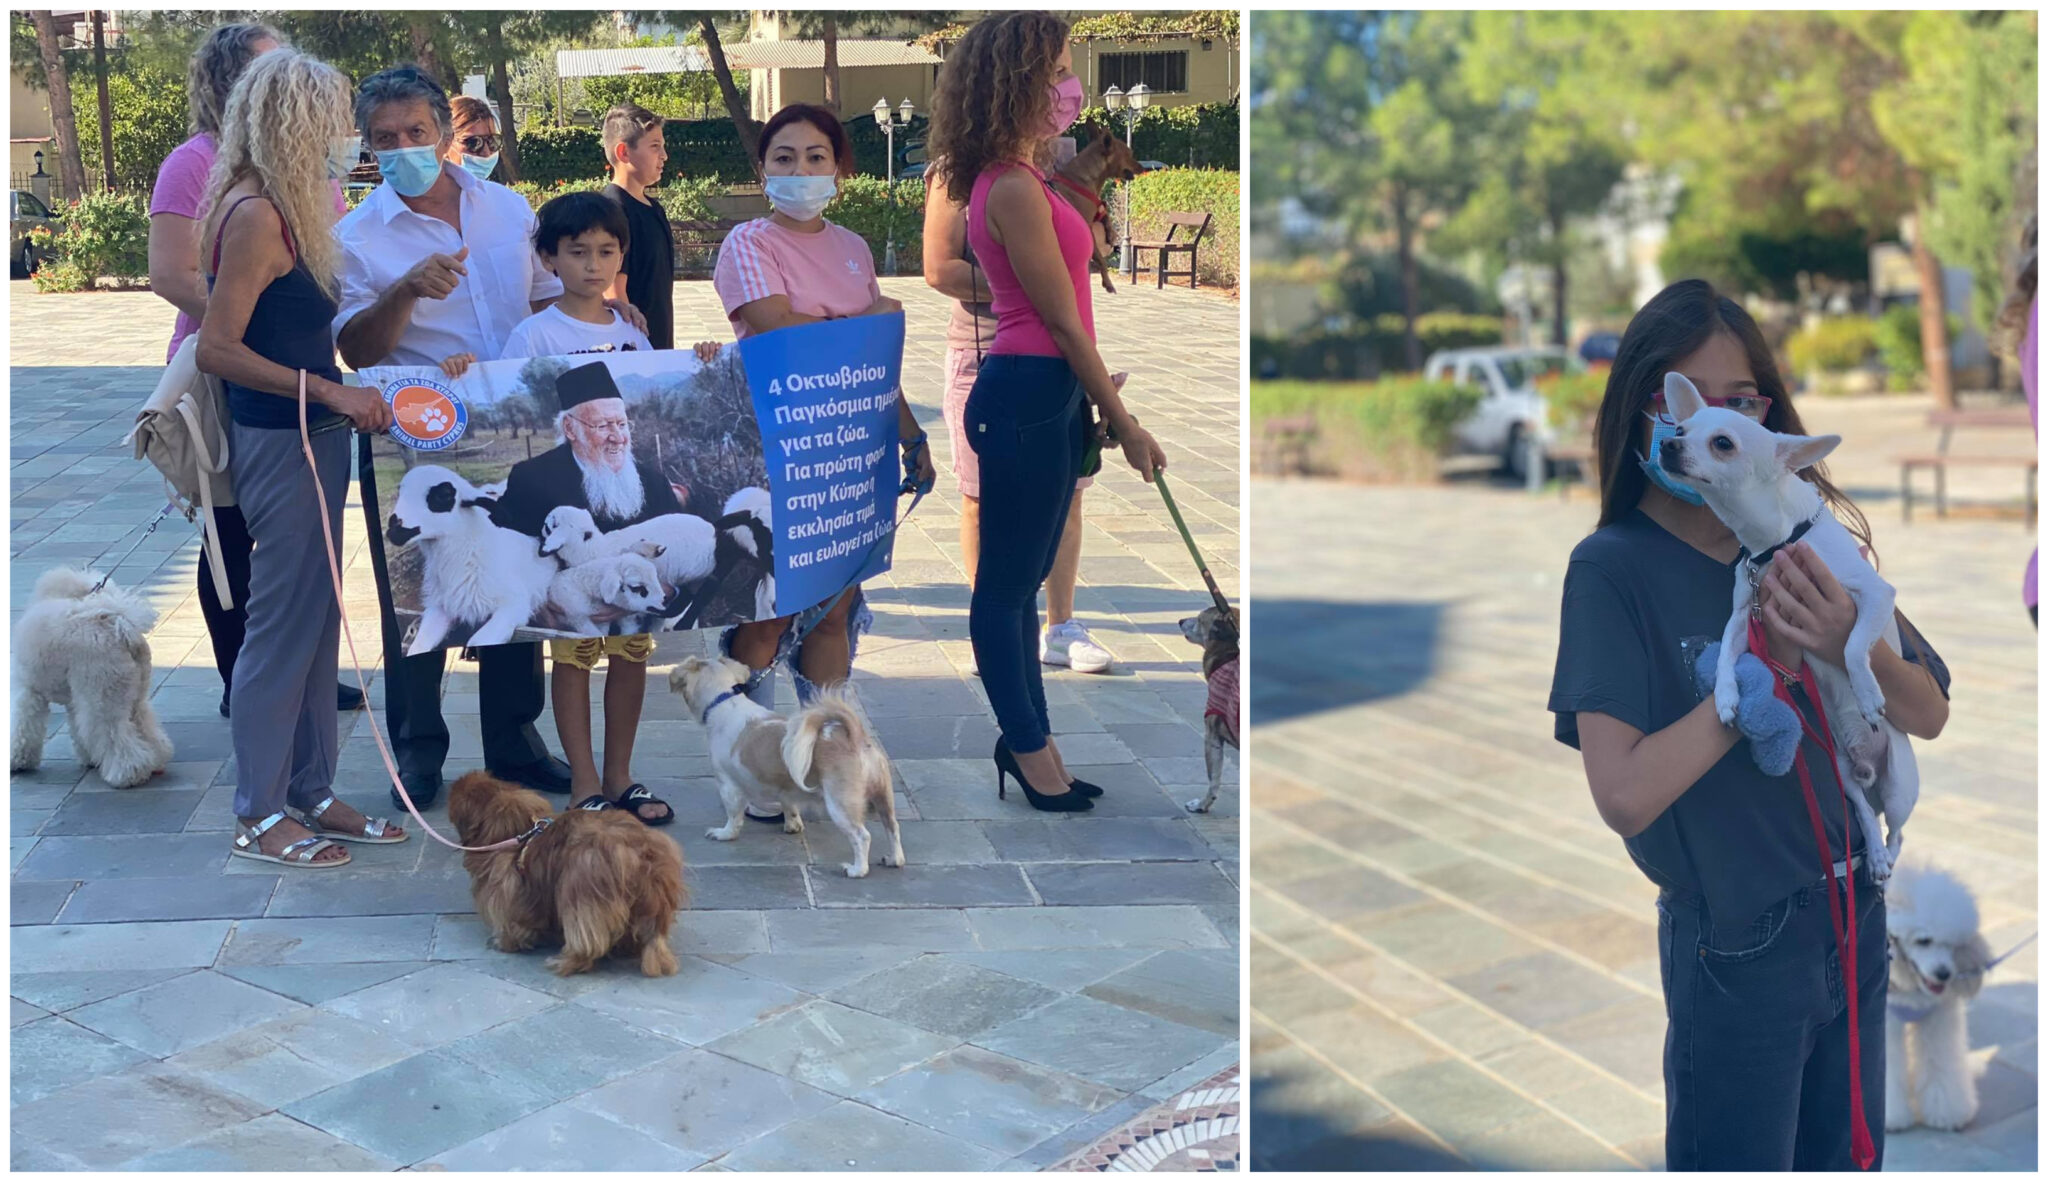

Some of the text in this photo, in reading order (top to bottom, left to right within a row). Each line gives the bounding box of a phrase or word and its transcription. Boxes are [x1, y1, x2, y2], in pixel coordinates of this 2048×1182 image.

[768, 364, 886, 396] 4 Οκτωβρίου
[774, 396, 872, 425] Παγκόσμια
[390, 421, 464, 449] ANIMAL PARTY CYPRUS
[779, 423, 869, 457] για τα ζώα.
[785, 462, 811, 482] Για
[813, 454, 863, 480] πρώτη
[786, 490, 826, 512] στην
[829, 481, 869, 502] Κύπρο
[788, 498, 875, 540] εκκλησία τιμά
[789, 551, 813, 569] και
[816, 531, 862, 563] ευλογεί
[862, 530, 873, 546] τα
